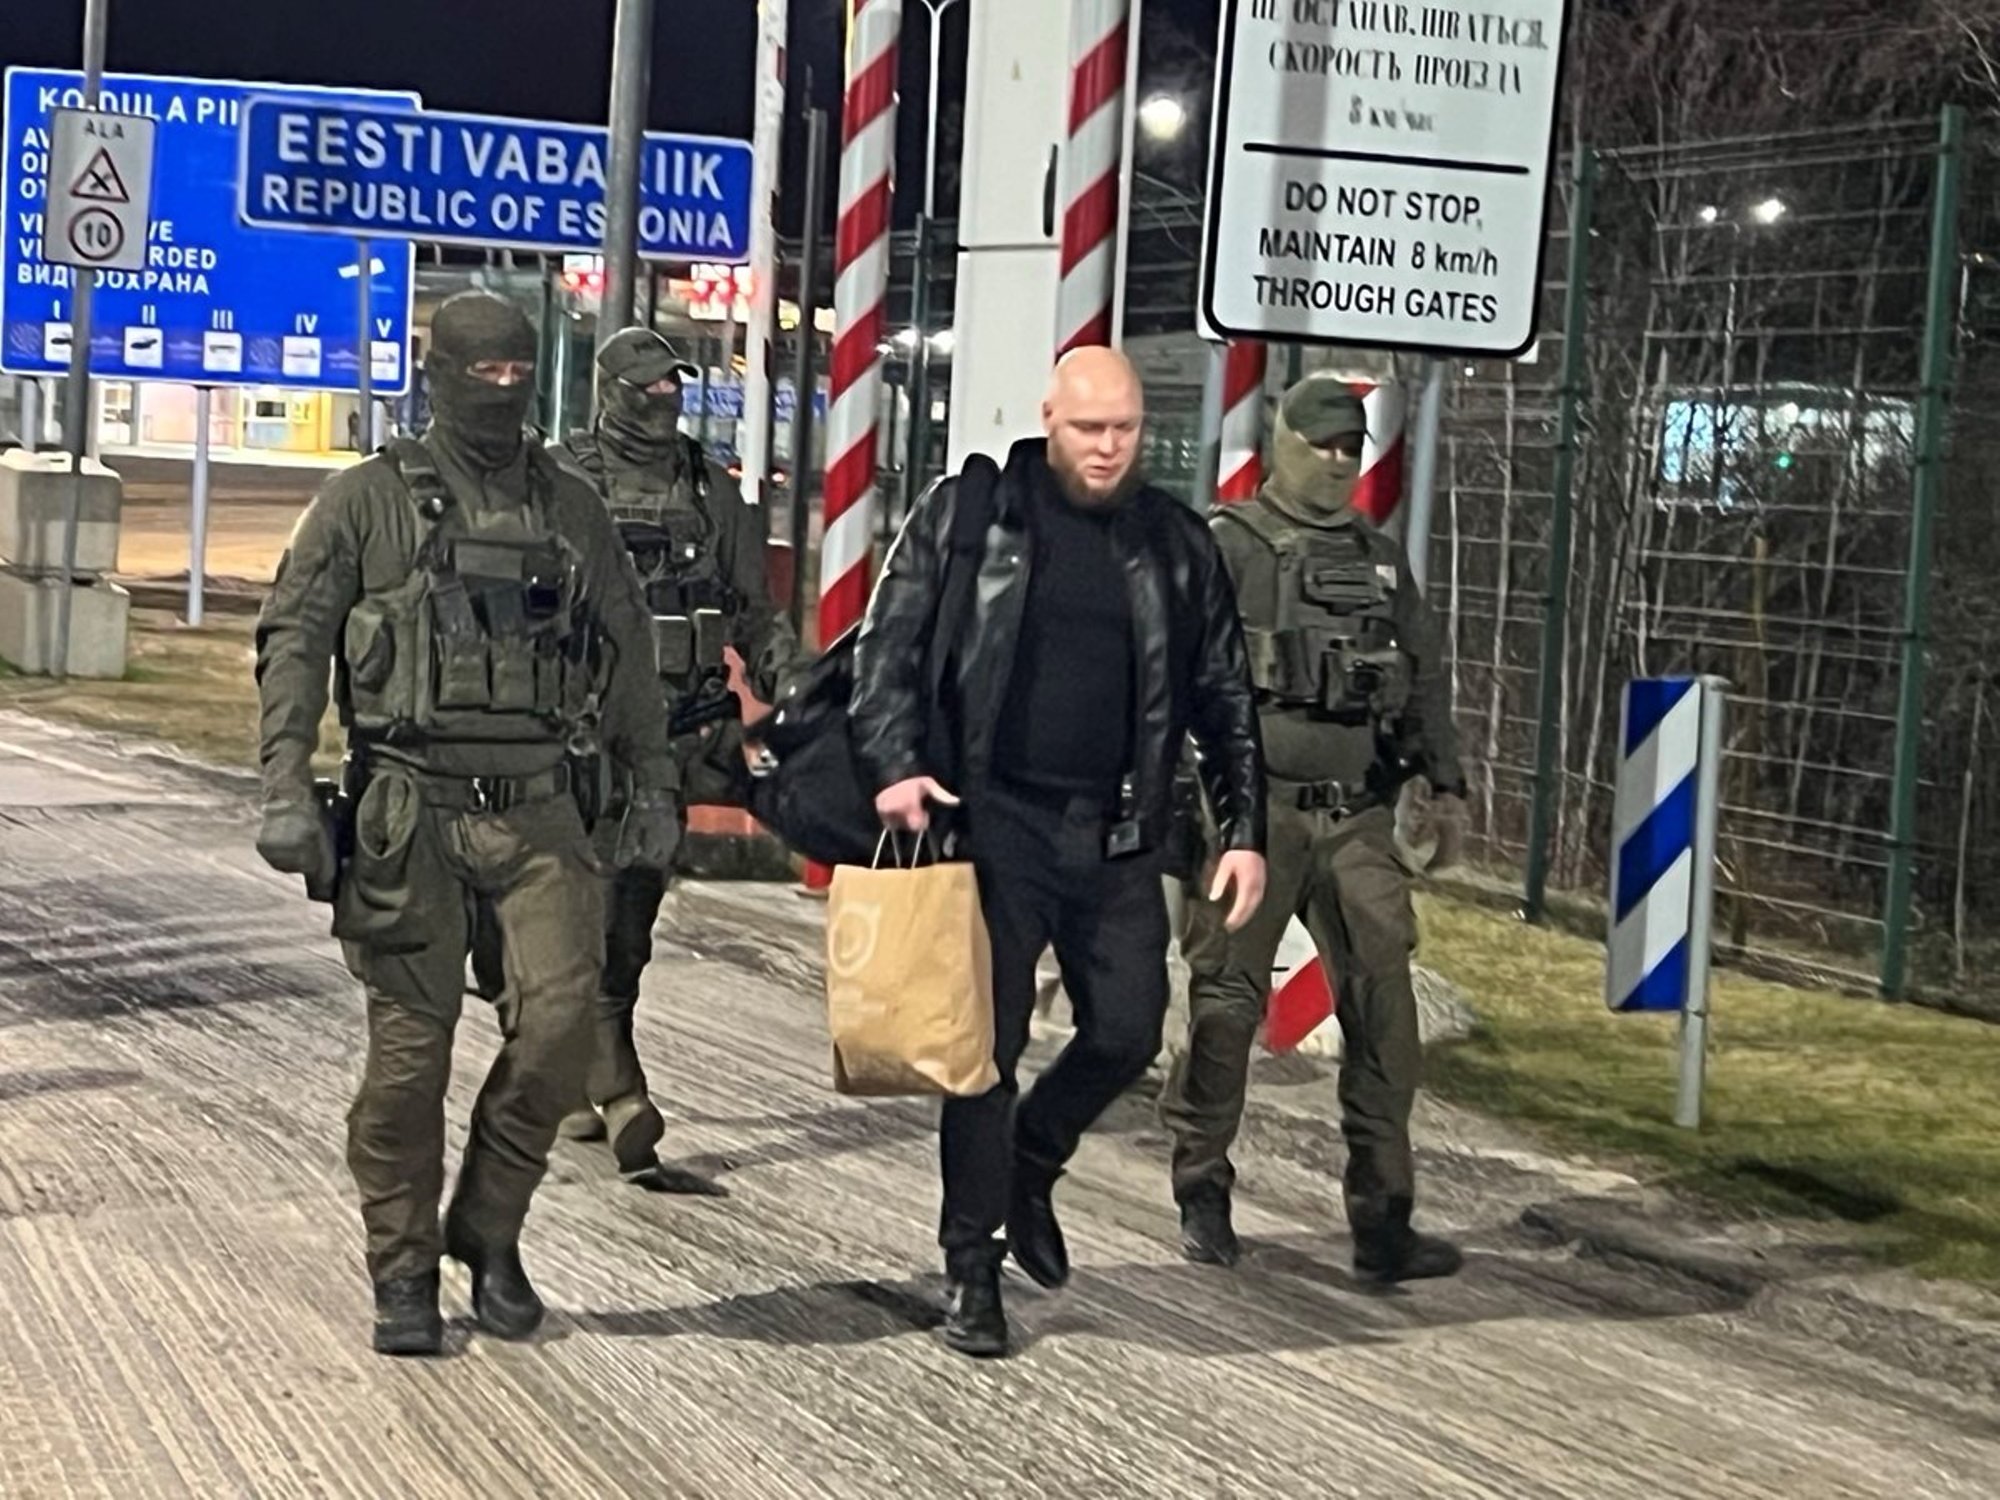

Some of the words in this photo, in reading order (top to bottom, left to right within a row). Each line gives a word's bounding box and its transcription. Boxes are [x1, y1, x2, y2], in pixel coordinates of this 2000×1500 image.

[39, 86, 188, 122] KODULA
[85, 118, 124, 139] ALA
[279, 115, 441, 174] EESTI
[461, 128, 723, 201] VABAIIK
[263, 174, 476, 228] REPUBLIC
[491, 196, 546, 232] OF
[558, 200, 733, 249] ESONIA
[1286, 181, 1327, 212] DO
[1337, 187, 1397, 218] NOT
[1405, 192, 1483, 231] STOP,
[85, 222, 111, 248] 10
[1259, 228, 1396, 267] MAINTAIN
[1411, 241, 1425, 269] 8
[1435, 243, 1498, 276] km/h
[53, 300, 61, 319] I
[1253, 275, 1396, 315] THROUGH
[1405, 289, 1498, 323] GATES
[142, 305, 156, 325] II
[212, 309, 233, 330] III
[295, 314, 318, 334] IV
[376, 318, 392, 338] V
